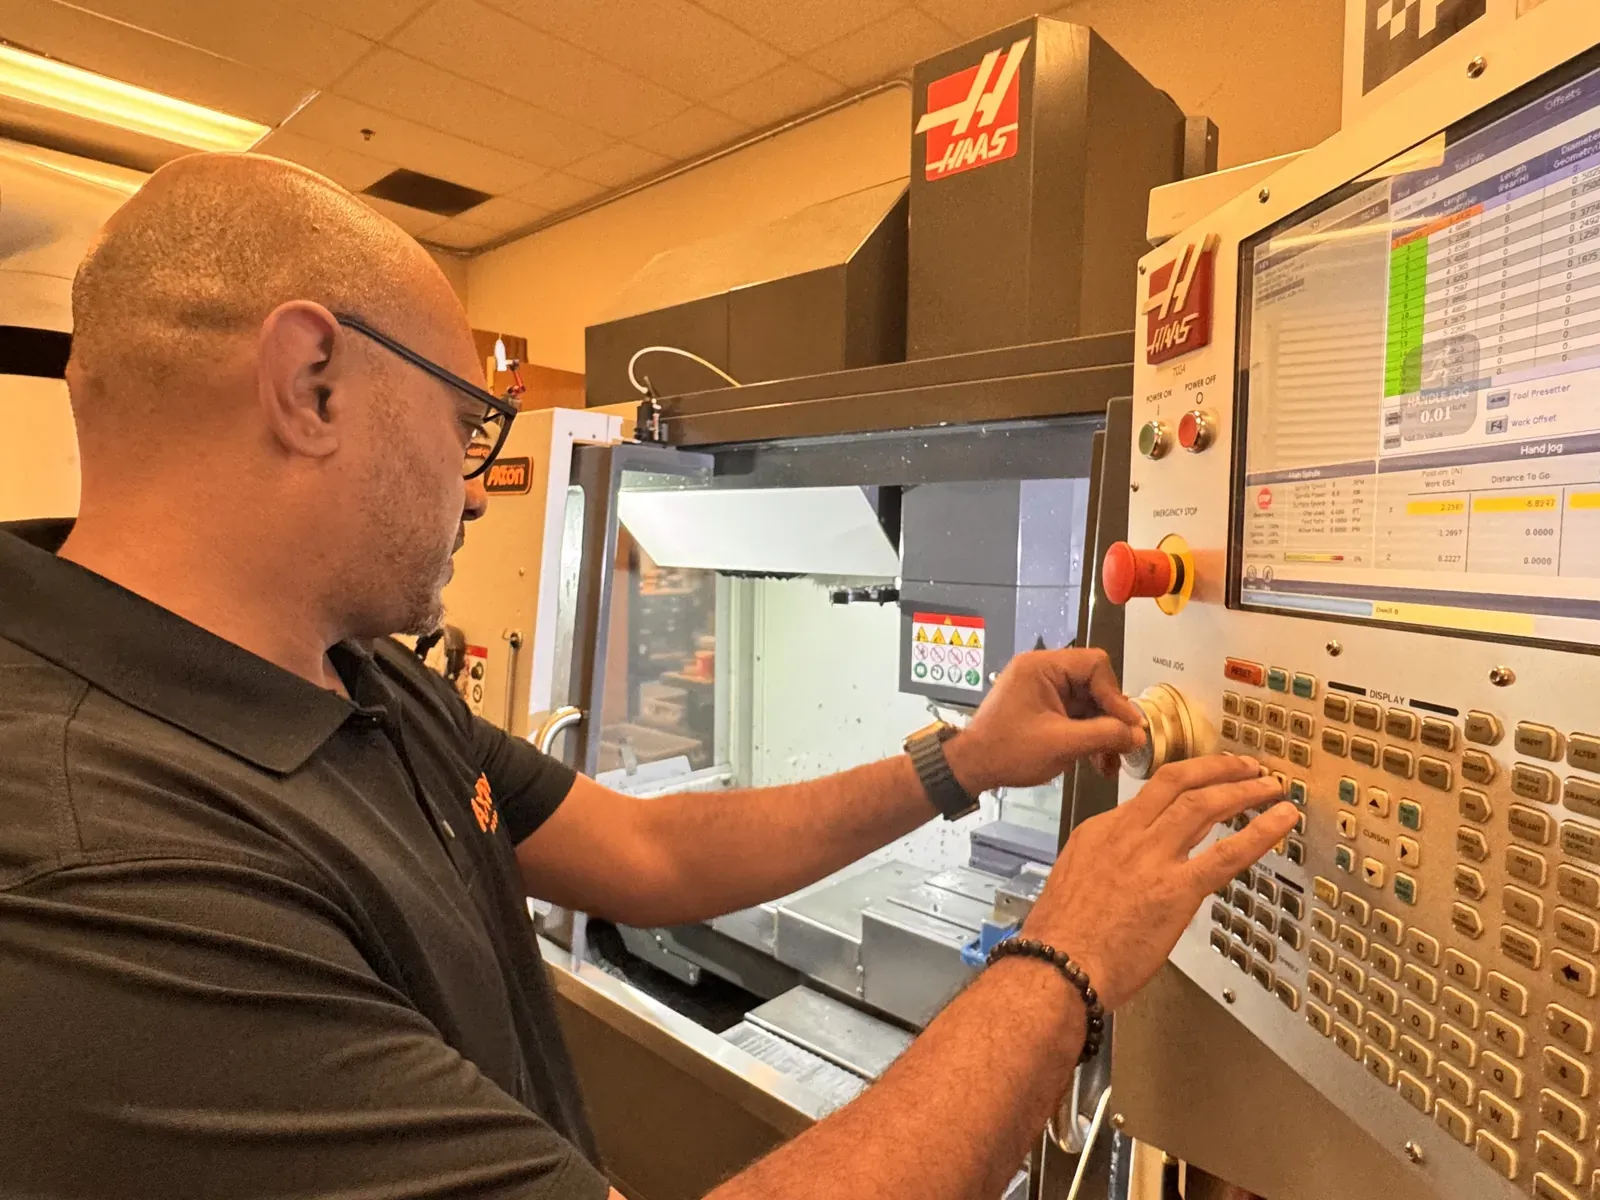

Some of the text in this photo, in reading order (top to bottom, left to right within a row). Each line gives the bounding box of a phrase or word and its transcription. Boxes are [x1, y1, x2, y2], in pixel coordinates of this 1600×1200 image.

[1543, 88, 1582, 111] Offsets
[925, 122, 1019, 174] HAAS
[1560, 131, 1600, 155] Diamete
[1499, 163, 1528, 183] Length
[1146, 312, 1200, 356] HAAS
[1184, 374, 1217, 391] POWER OFF
[1146, 389, 1173, 403] POWER ON
[1407, 385, 1470, 408] HANDLE JOG
[1513, 390, 1530, 401] Tool
[1531, 384, 1571, 397] Presetter
[1420, 406, 1452, 423] 0.01
[1490, 414, 1557, 432] F4 Work Offset
[1520, 443, 1563, 455] Hand Jog
[1442, 479, 1455, 487] G54
[1491, 474, 1525, 484] Distance
[1538, 472, 1551, 480] Go
[1153, 507, 1198, 518] EMERGENCY STOP
[1525, 528, 1554, 536] 0.0000
[1523, 557, 1552, 565] 0.0000
[1152, 656, 1185, 672] HANDLE JOG
[1369, 690, 1405, 705] DISPLAY
[1269, 711, 1278, 723] F3
[1294, 718, 1304, 730] F4
[1573, 749, 1598, 760] ALTER
[1510, 818, 1542, 832] COOLANT
[1362, 829, 1391, 846] CURSOR
[1415, 942, 1425, 954] C
[1455, 963, 1465, 976] D
[1499, 987, 1510, 1002] E
[1454, 1004, 1462, 1015] J
[1560, 1020, 1571, 1034] 7
[1495, 1028, 1506, 1042] K
[1490, 1106, 1502, 1123] W
